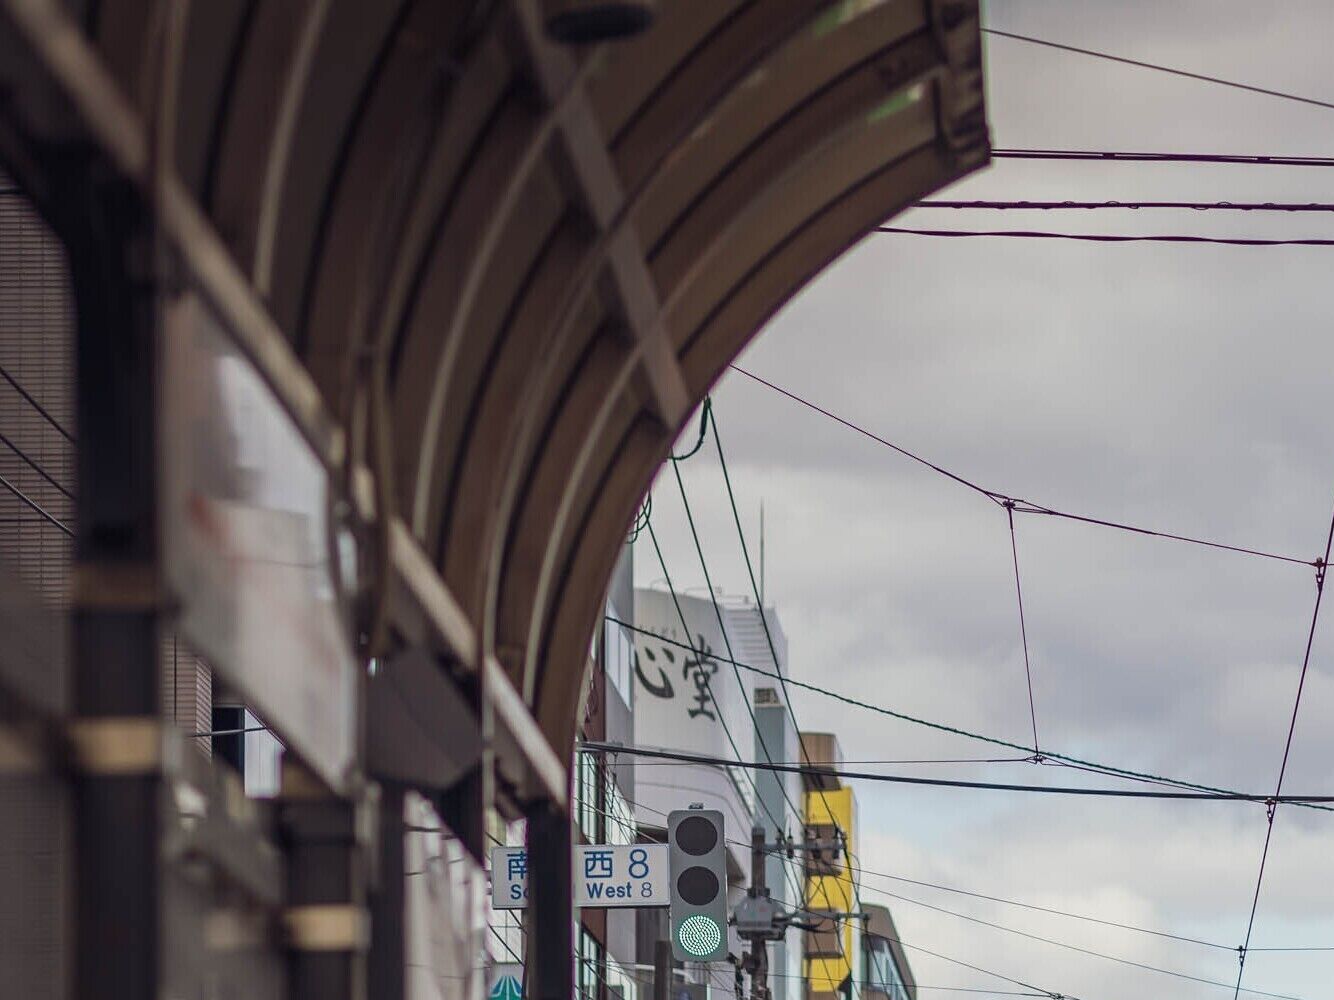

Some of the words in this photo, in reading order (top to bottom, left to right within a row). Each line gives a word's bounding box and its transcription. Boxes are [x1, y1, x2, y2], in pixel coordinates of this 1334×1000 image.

[584, 850, 614, 879] 西
[628, 849, 649, 879] 8
[586, 881, 632, 899] West
[641, 881, 653, 898] 8
